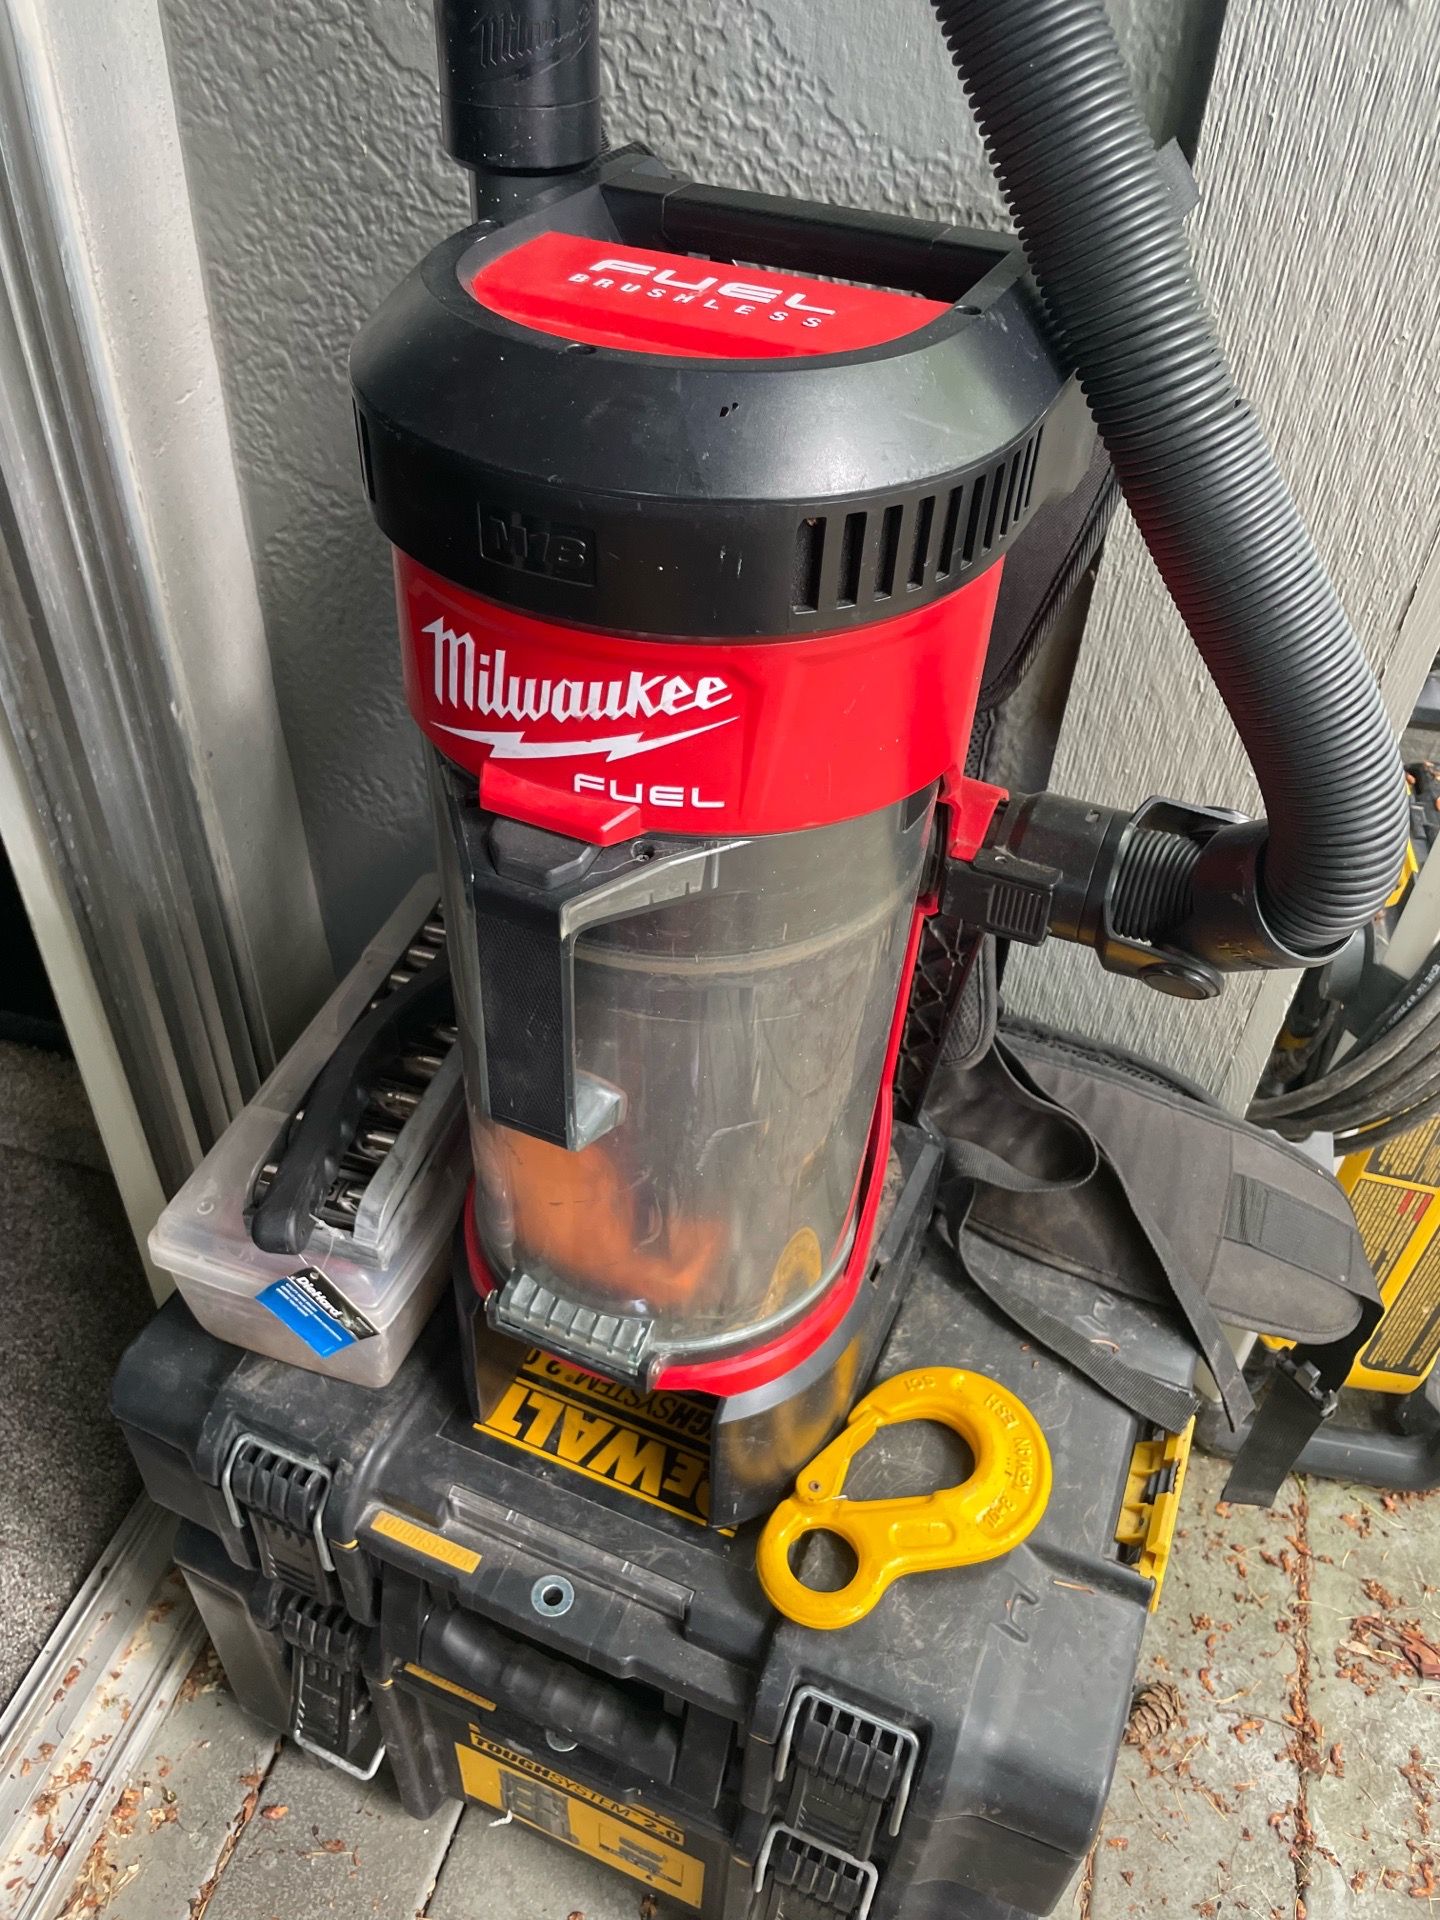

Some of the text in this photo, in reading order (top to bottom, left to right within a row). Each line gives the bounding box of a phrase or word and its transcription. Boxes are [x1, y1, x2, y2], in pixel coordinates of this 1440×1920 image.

[568, 273, 822, 328] BRUSHLESS
[588, 258, 836, 316] FUEL
[421, 616, 733, 723] Milwaukee
[574, 773, 725, 808] FUEL
[643, 1817, 681, 1844] 2.0
